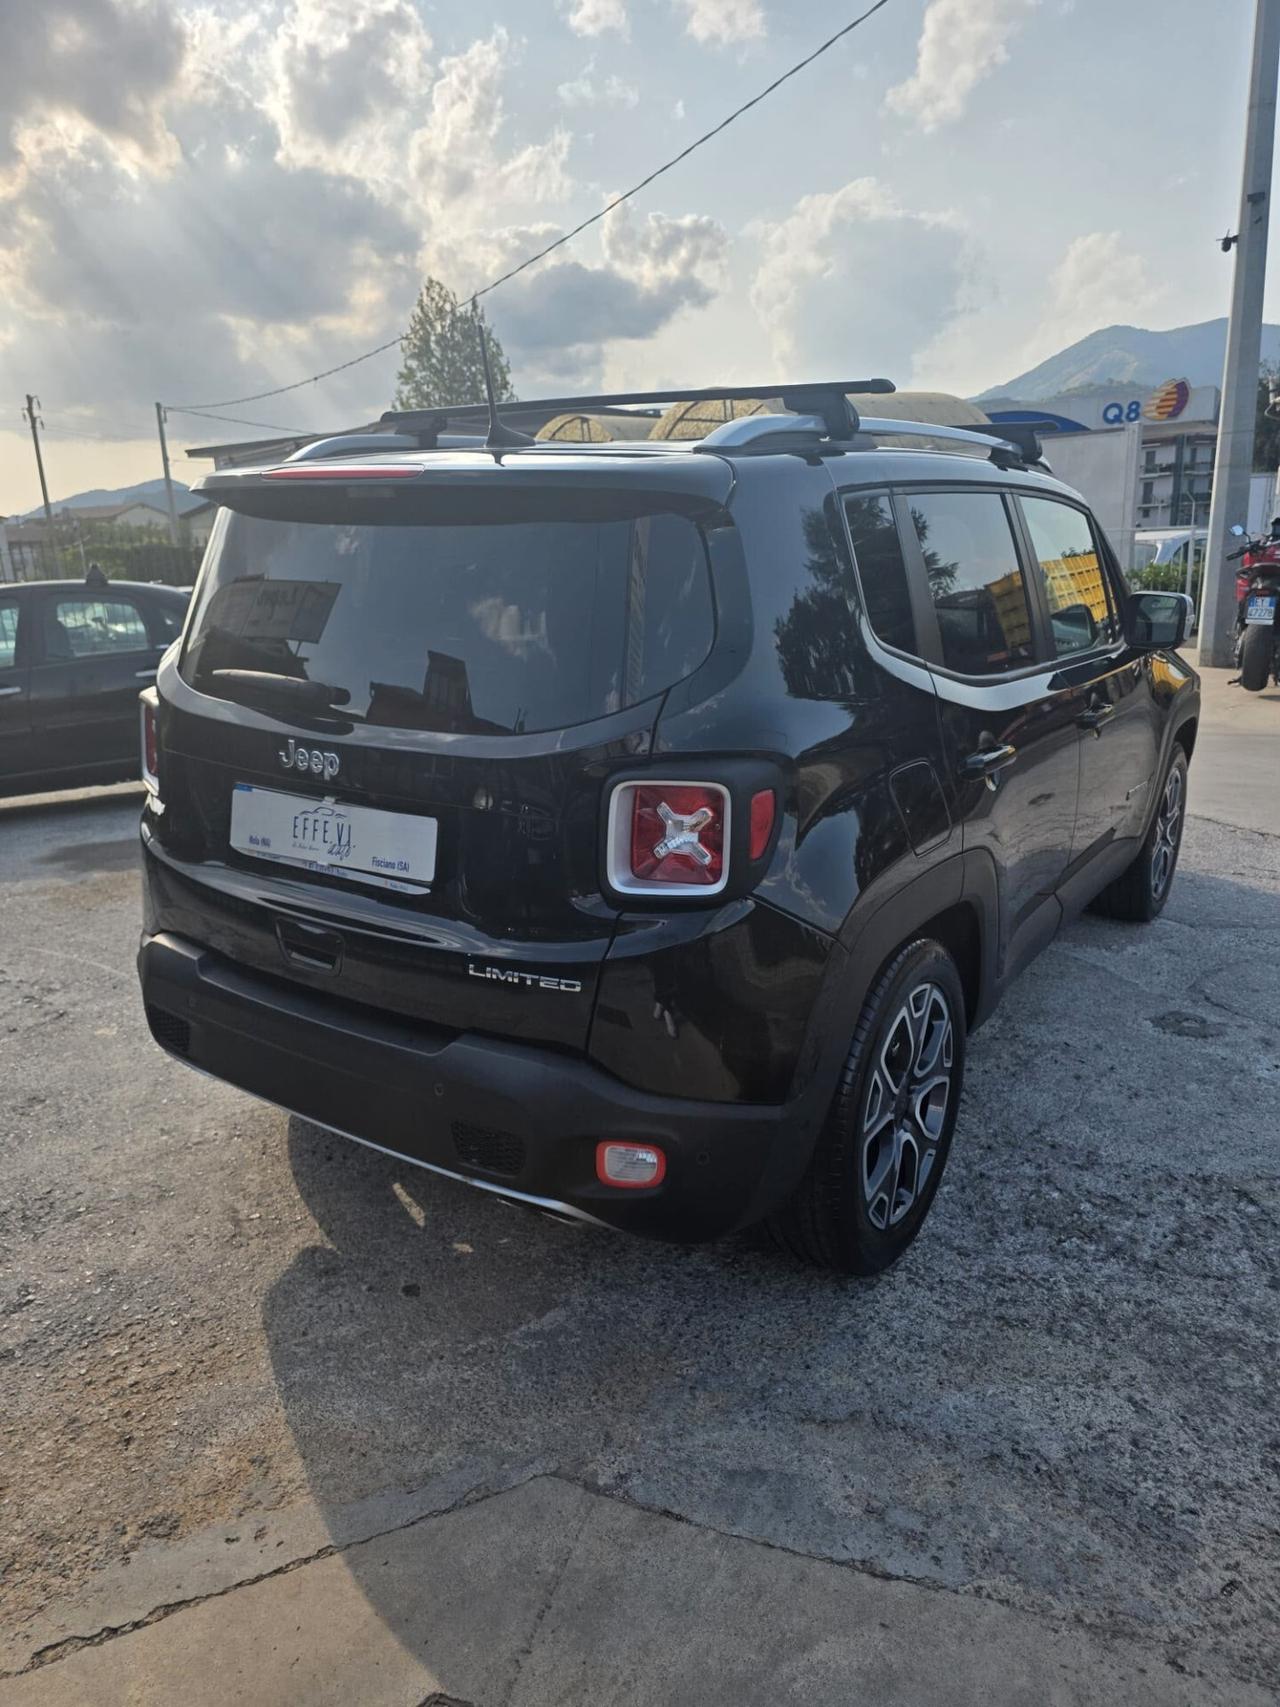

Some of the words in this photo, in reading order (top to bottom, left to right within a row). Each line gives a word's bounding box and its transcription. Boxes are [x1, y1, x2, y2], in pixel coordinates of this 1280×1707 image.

[1103, 400, 1140, 425] Q8
[279, 739, 340, 780] Jeep
[371, 856, 397, 871] Fisciano
[468, 963, 582, 992] LIMITED
